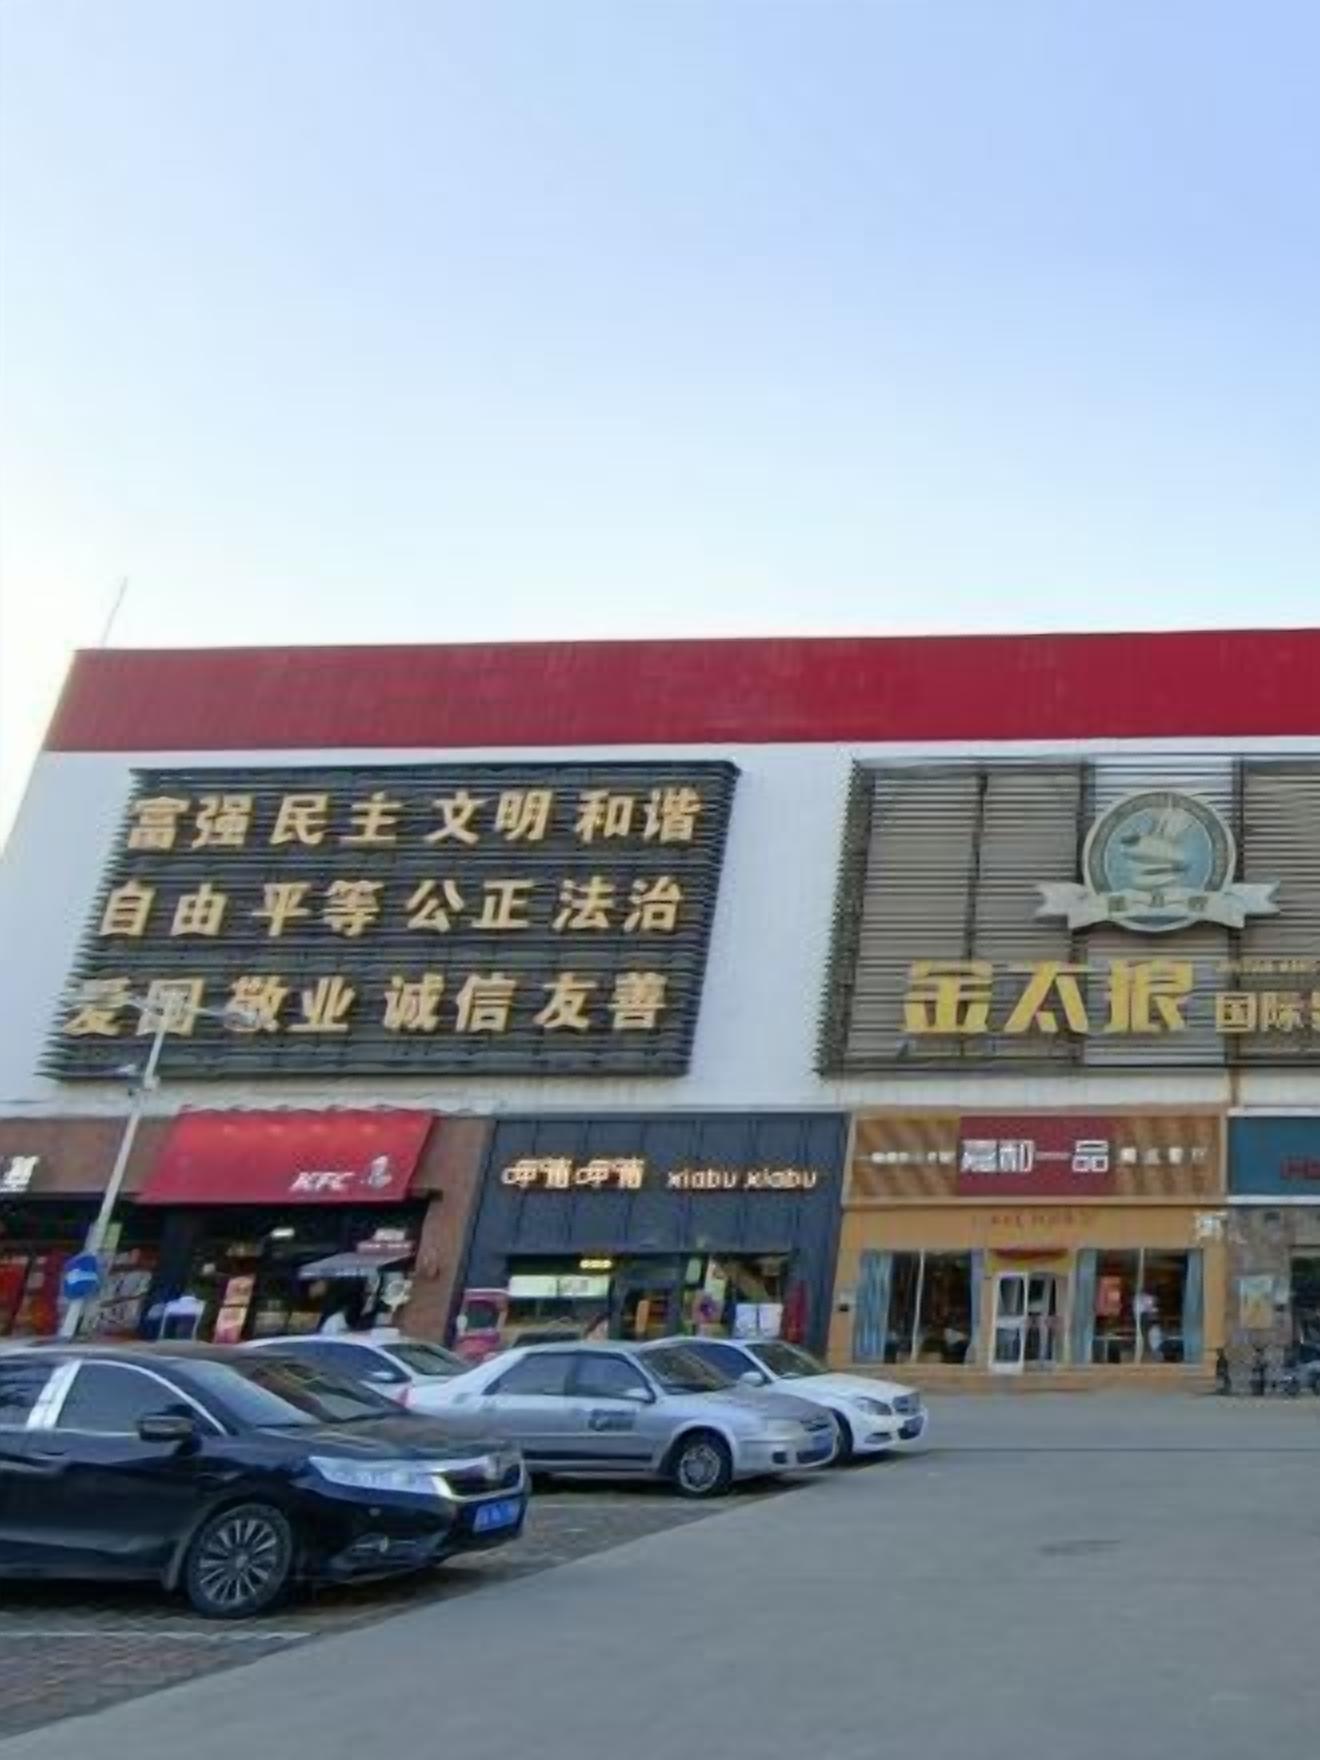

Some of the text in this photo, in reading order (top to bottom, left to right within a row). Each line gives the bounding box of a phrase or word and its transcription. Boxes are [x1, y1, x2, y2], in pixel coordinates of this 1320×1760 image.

[126, 787, 702, 851] 富强民主文明和谐
[99, 876, 684, 938] 自由平等公正法治
[289, 1171, 356, 1192] KFC
